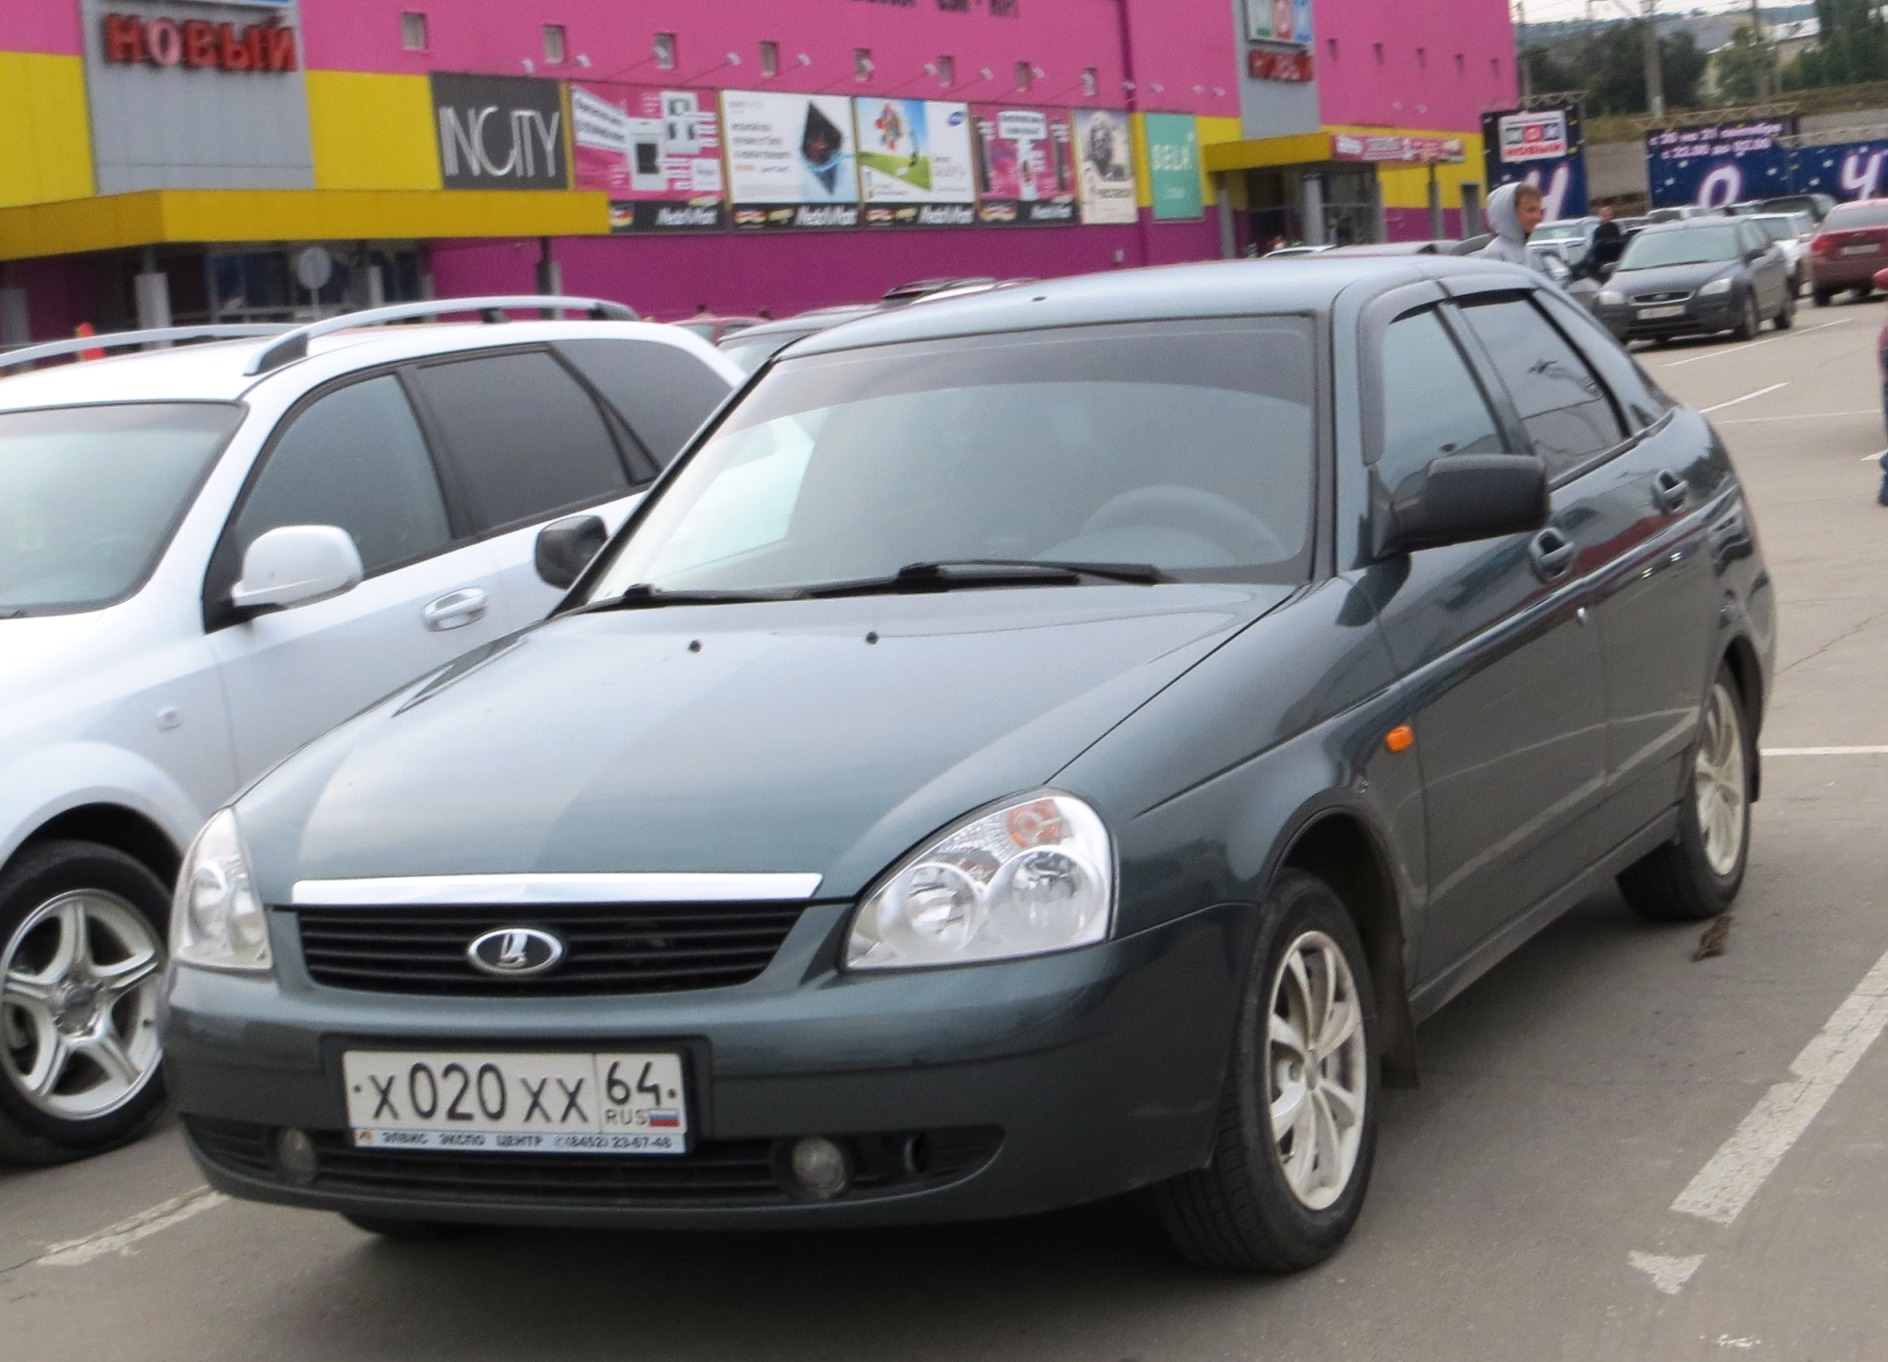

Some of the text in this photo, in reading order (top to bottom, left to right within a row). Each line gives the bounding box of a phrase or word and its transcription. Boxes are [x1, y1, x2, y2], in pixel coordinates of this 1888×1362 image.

[103, 13, 297, 72] НОВЫЙ
[438, 106, 560, 178] INCITY
[606, 1061, 661, 1106] 64
[604, 1109, 649, 1127] RUS
